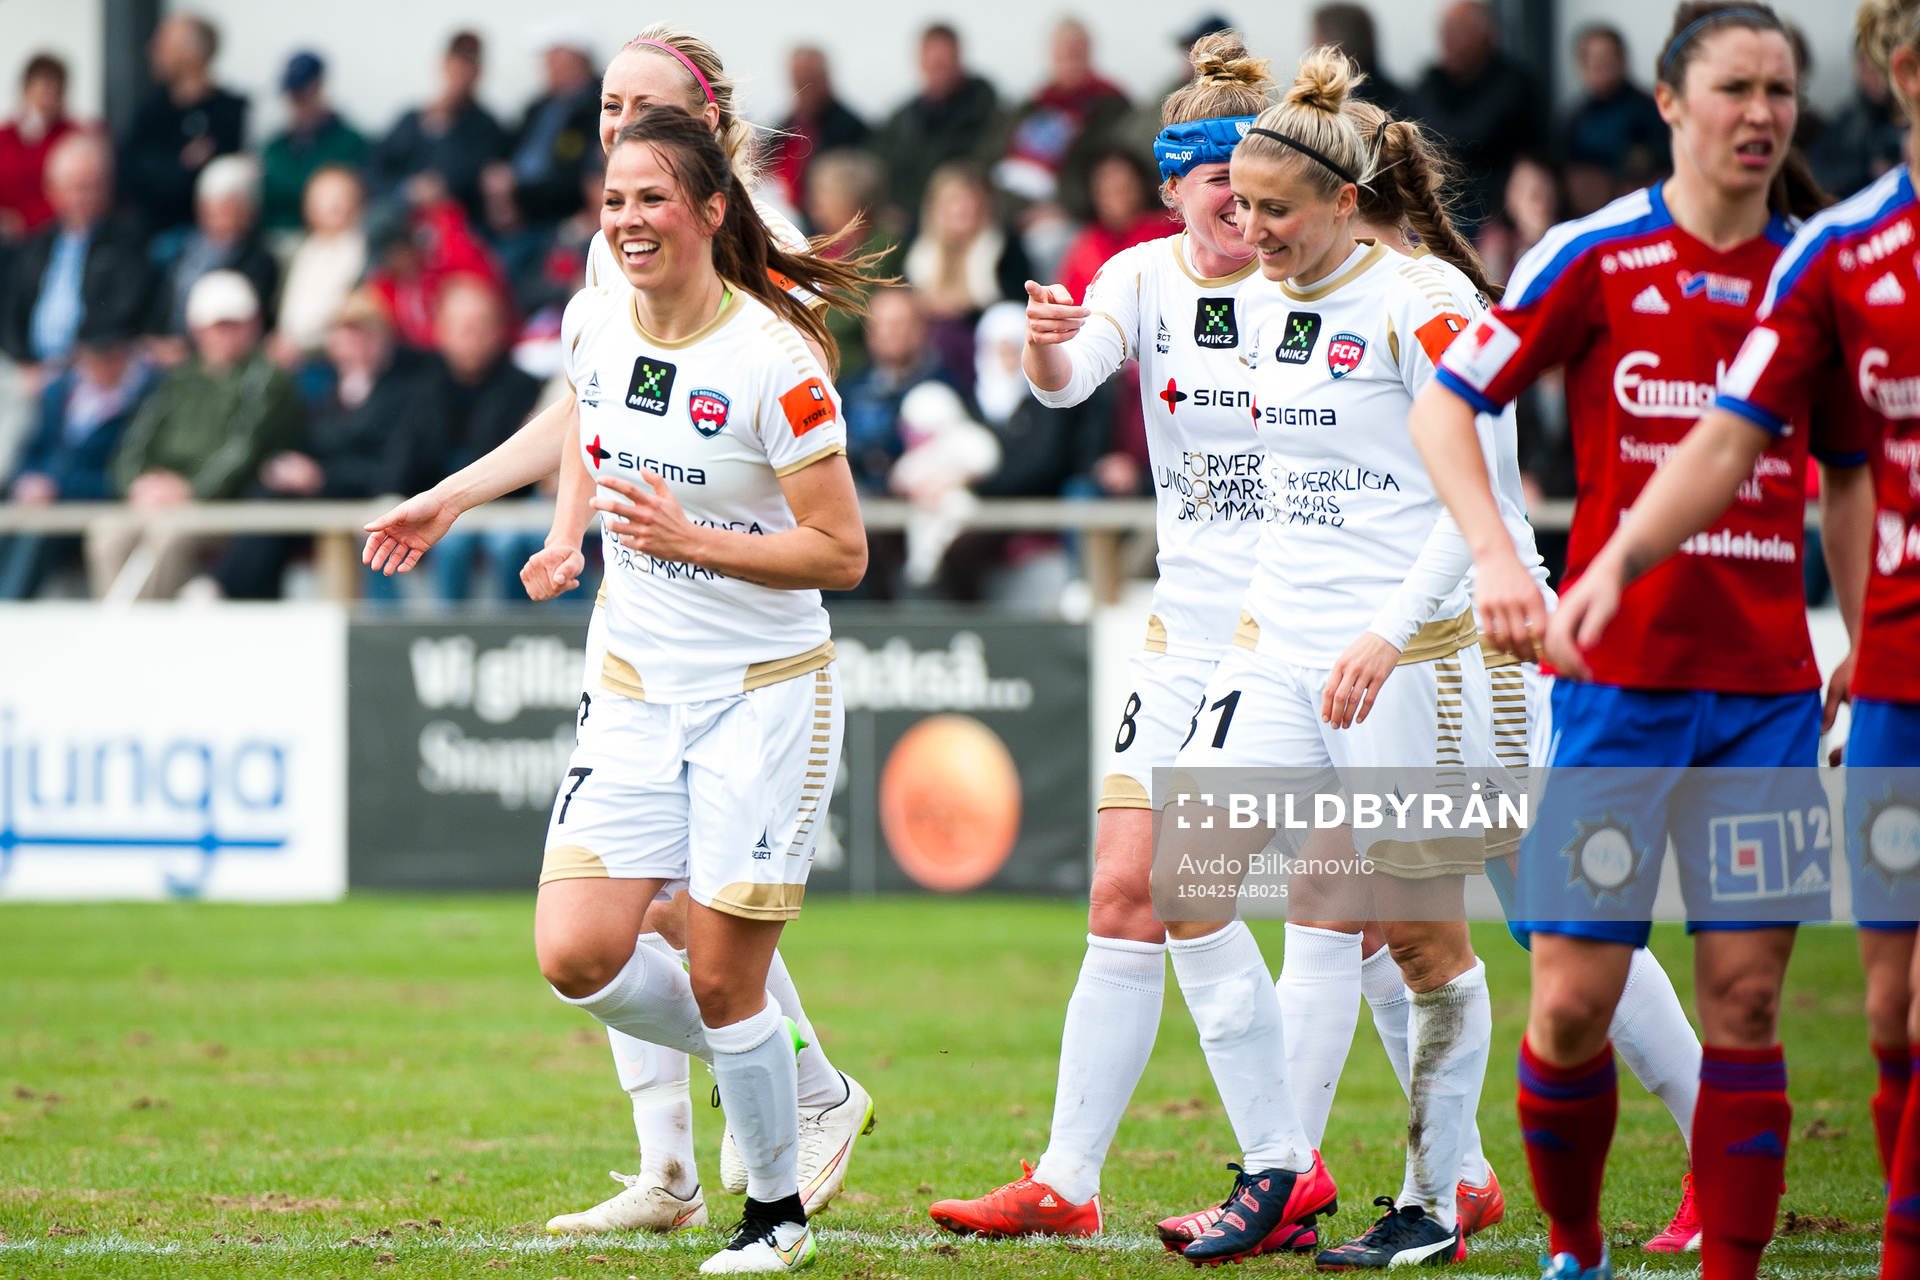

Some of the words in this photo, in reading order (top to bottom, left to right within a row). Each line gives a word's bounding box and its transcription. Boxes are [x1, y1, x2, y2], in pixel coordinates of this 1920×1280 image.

[1198, 334, 1234, 344] MIKZ
[1279, 348, 1309, 361] MIKZ
[1330, 344, 1360, 360] FCR
[628, 394, 665, 412] MIKZ
[1115, 692, 1141, 753] 8
[558, 767, 594, 825] 7
